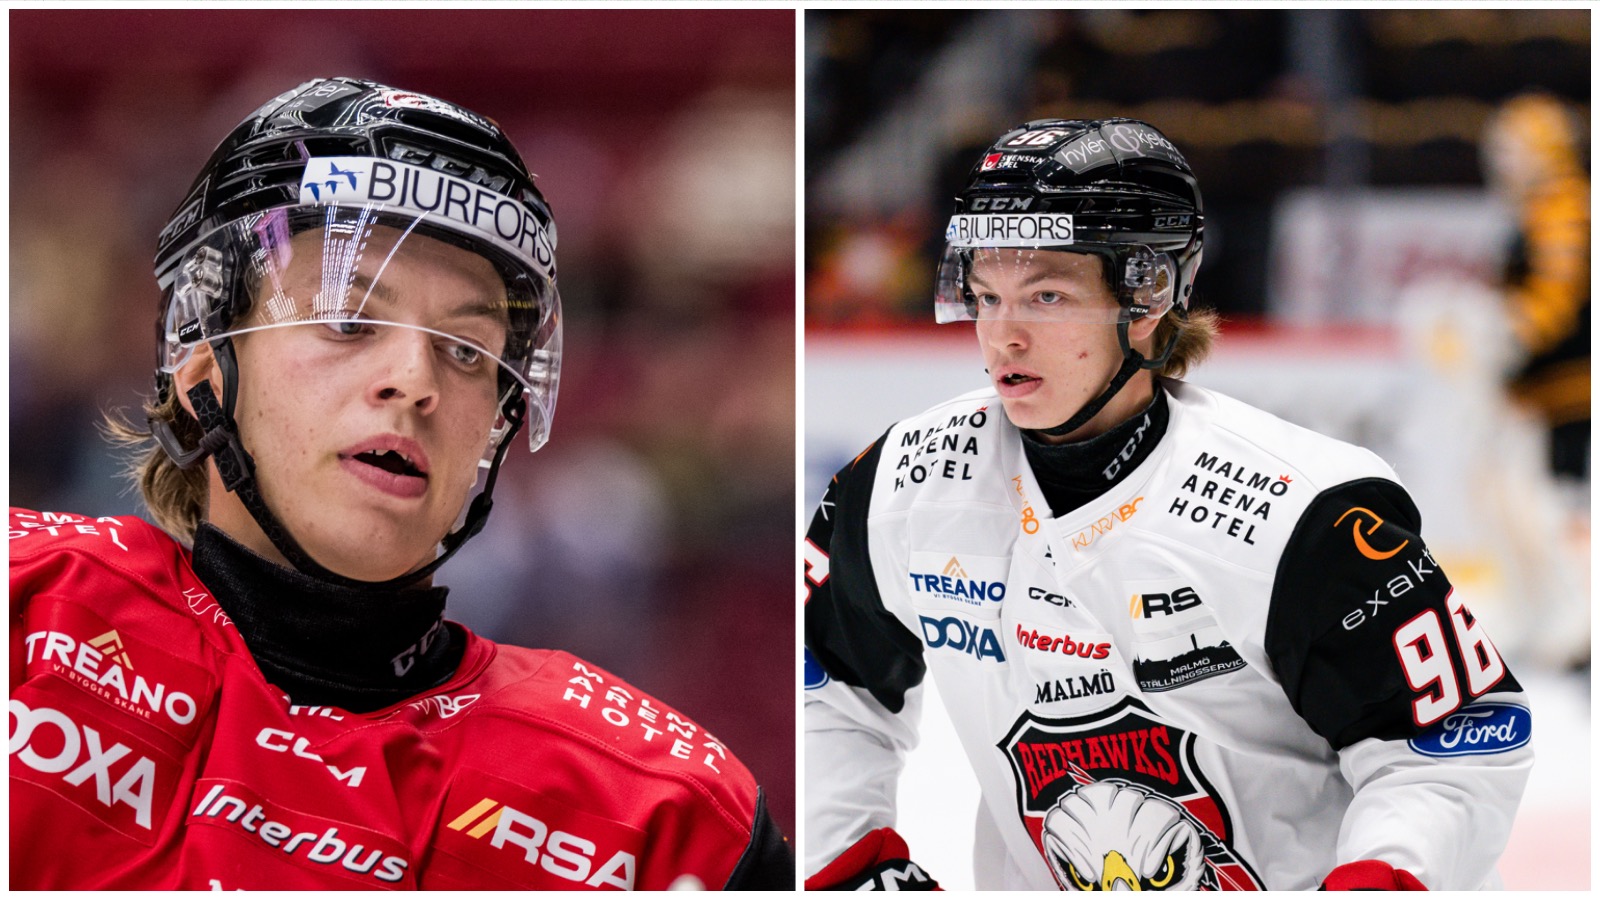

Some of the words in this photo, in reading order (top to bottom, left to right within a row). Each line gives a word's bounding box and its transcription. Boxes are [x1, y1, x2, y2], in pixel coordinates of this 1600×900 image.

[389, 142, 509, 192] CCM
[996, 161, 1018, 169] SPEL
[1001, 154, 1046, 164] SVENSKA
[367, 161, 553, 267] BJURFORS
[970, 197, 1034, 211] CCM
[1154, 215, 1190, 227] CCM
[960, 216, 1071, 244] BJURFORS
[180, 322, 200, 337] CCM
[897, 434, 979, 471] ARENA
[1102, 413, 1152, 481] CCM
[894, 459, 973, 493] HOTEL
[1194, 451, 1291, 497] MALMÖ
[1181, 474, 1272, 521] ARENA
[1168, 496, 1256, 546] HOTEL
[908, 572, 1006, 602] TREANO
[918, 614, 1006, 664] DOXA
[1015, 624, 1112, 660] Interbus
[1391, 584, 1506, 728] 96
[25, 630, 197, 726] TREANO
[53, 663, 66, 674] VI
[68, 671, 111, 700] BYGGER
[1139, 658, 1248, 689] STÄLLNINGSSERVIC
[1170, 656, 1211, 677] MALMÖ
[1034, 668, 1116, 705] MALMÖ
[562, 687, 721, 775] HOTEL
[567, 675, 727, 761] ARENA
[1439, 709, 1518, 749] Ford
[1017, 725, 1180, 800] REDHAWKS
[192, 783, 409, 883] Interbus
